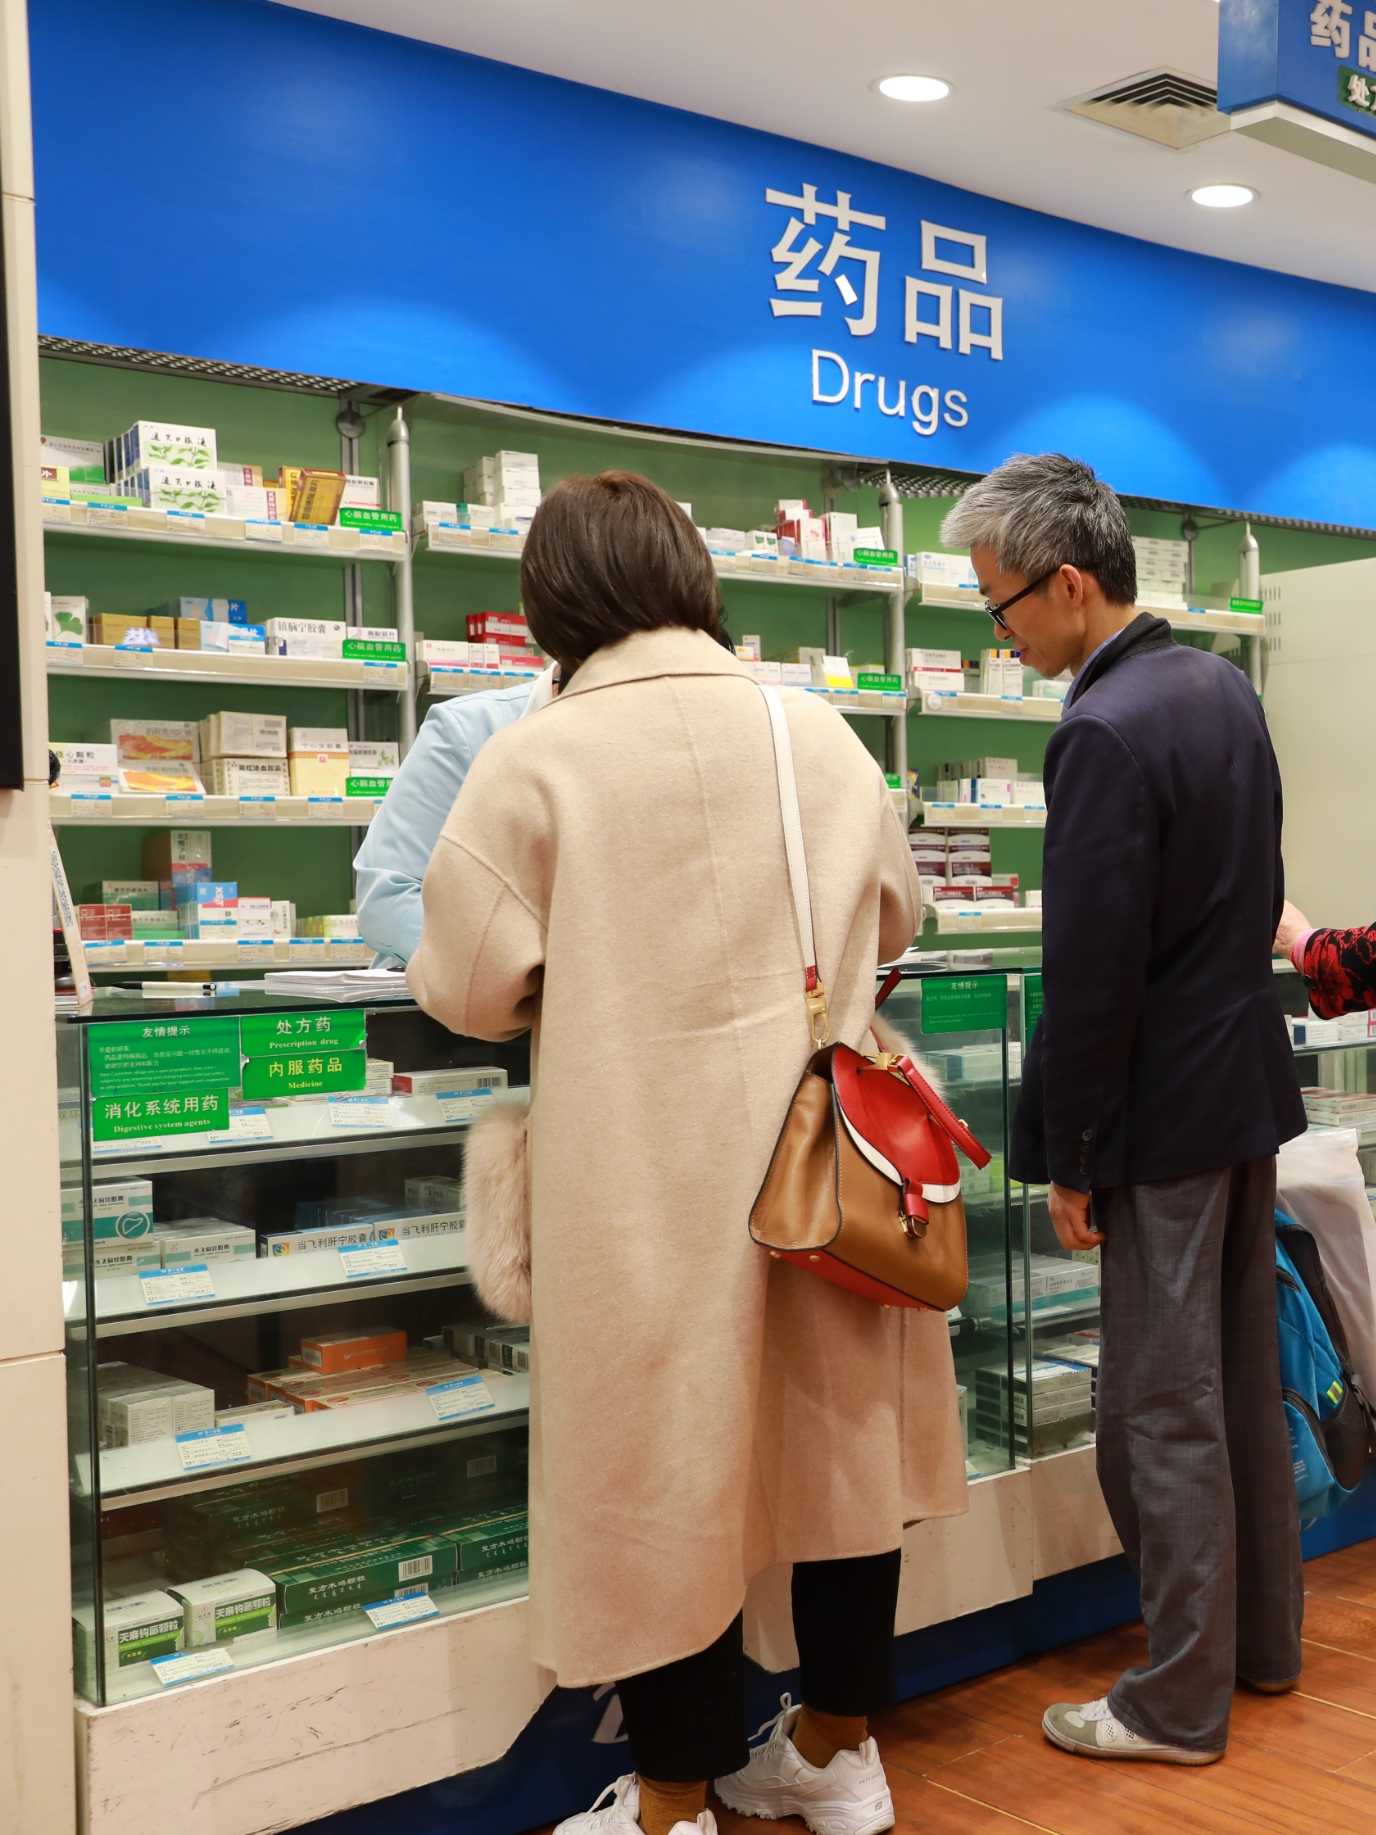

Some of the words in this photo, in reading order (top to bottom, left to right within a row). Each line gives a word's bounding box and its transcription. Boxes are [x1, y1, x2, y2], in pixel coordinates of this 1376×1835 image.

[765, 182, 1004, 361] 药品
[811, 348, 969, 436] Drugs
[344, 510, 398, 523] 心脑血管用药
[277, 621, 327, 635] 镇脑宁胶囊
[347, 641, 402, 654] 心脑血管用药
[950, 980, 979, 991] 友情提示
[141, 1024, 192, 1039] 友情提示
[276, 1015, 332, 1035] 处方药
[269, 1039, 318, 1049] Prescription
[320, 1037, 339, 1046] drug
[268, 1057, 343, 1078] 内服药品
[287, 1080, 324, 1090] Medicine
[104, 1094, 220, 1120] 消化系统用药
[113, 1124, 153, 1134] Digestive
[154, 1120, 183, 1131] system
[184, 1118, 211, 1128] agents
[401, 1219, 466, 1237] 当飞利肝宁胶囊
[297, 1232, 368, 1251] 当飞利肝宁胶囊
[308, 1573, 367, 1595] 复方木鸡颗粒
[215, 1595, 272, 1620] 天麻钩藤颗粒
[304, 1601, 362, 1623] 复方木鸡颗粒
[119, 1619, 179, 1643] 天麻钩藤颗粒
